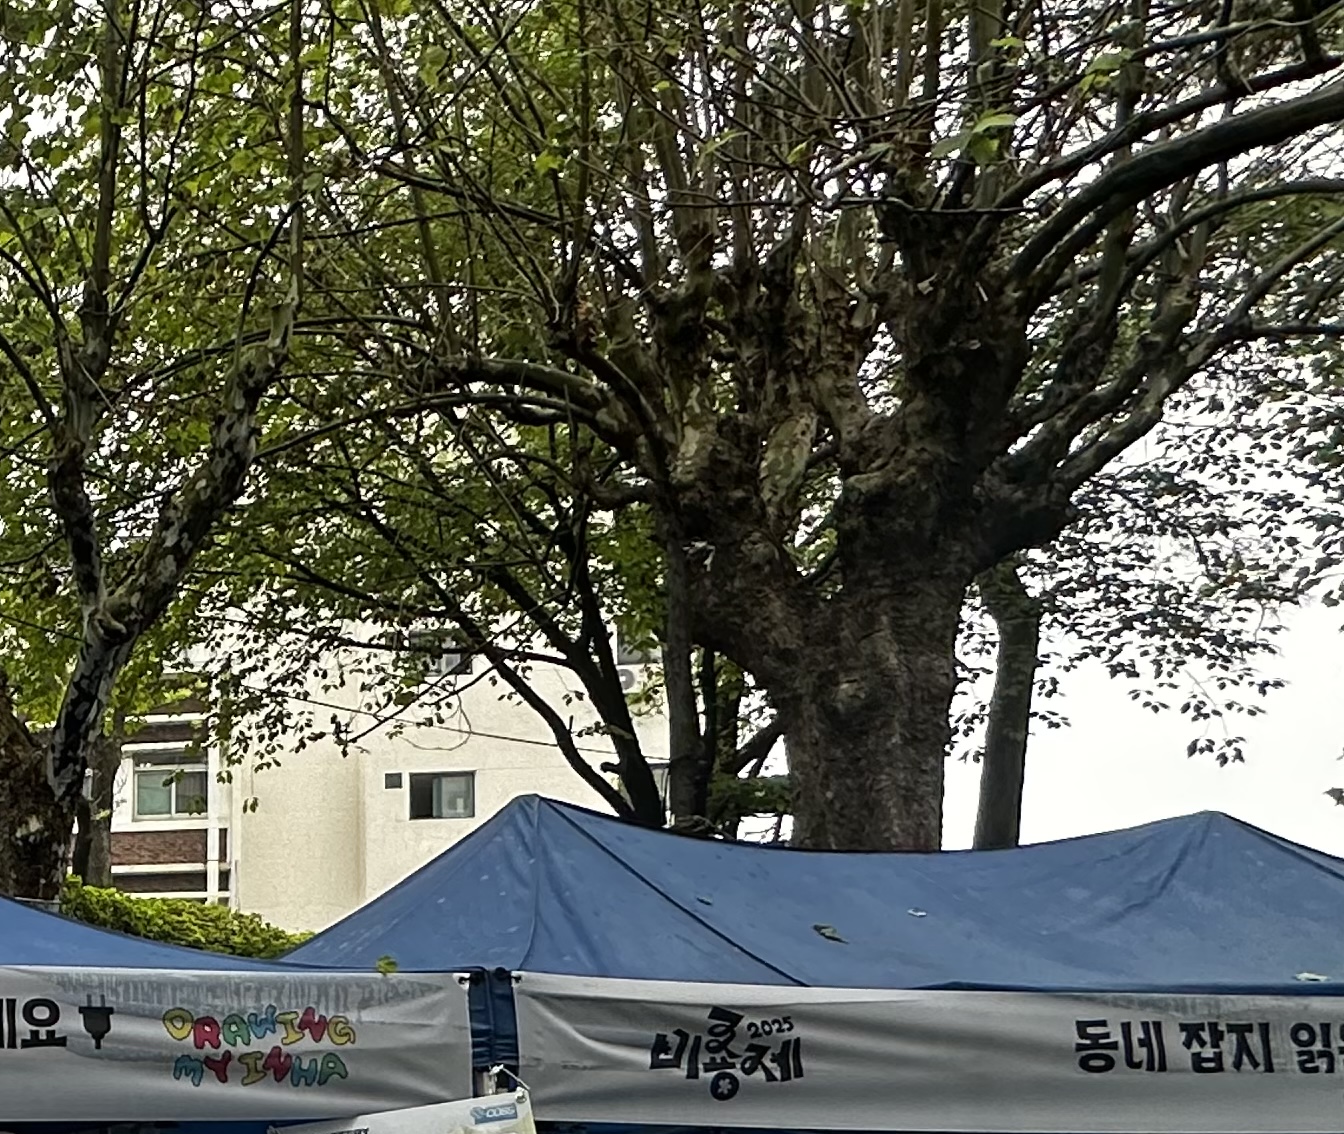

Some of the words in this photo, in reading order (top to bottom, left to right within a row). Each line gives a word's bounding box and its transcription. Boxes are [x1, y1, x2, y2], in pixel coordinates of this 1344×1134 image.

[162, 1004, 356, 1049] DRAWING
[747, 1016, 794, 1039] 2025
[1074, 1020, 1167, 1074] 동네
[1178, 1021, 1274, 1074] 잡지
[173, 1049, 232, 1087] MY
[238, 1046, 348, 1086] INHA
[649, 1006, 804, 1101] 비룡제
